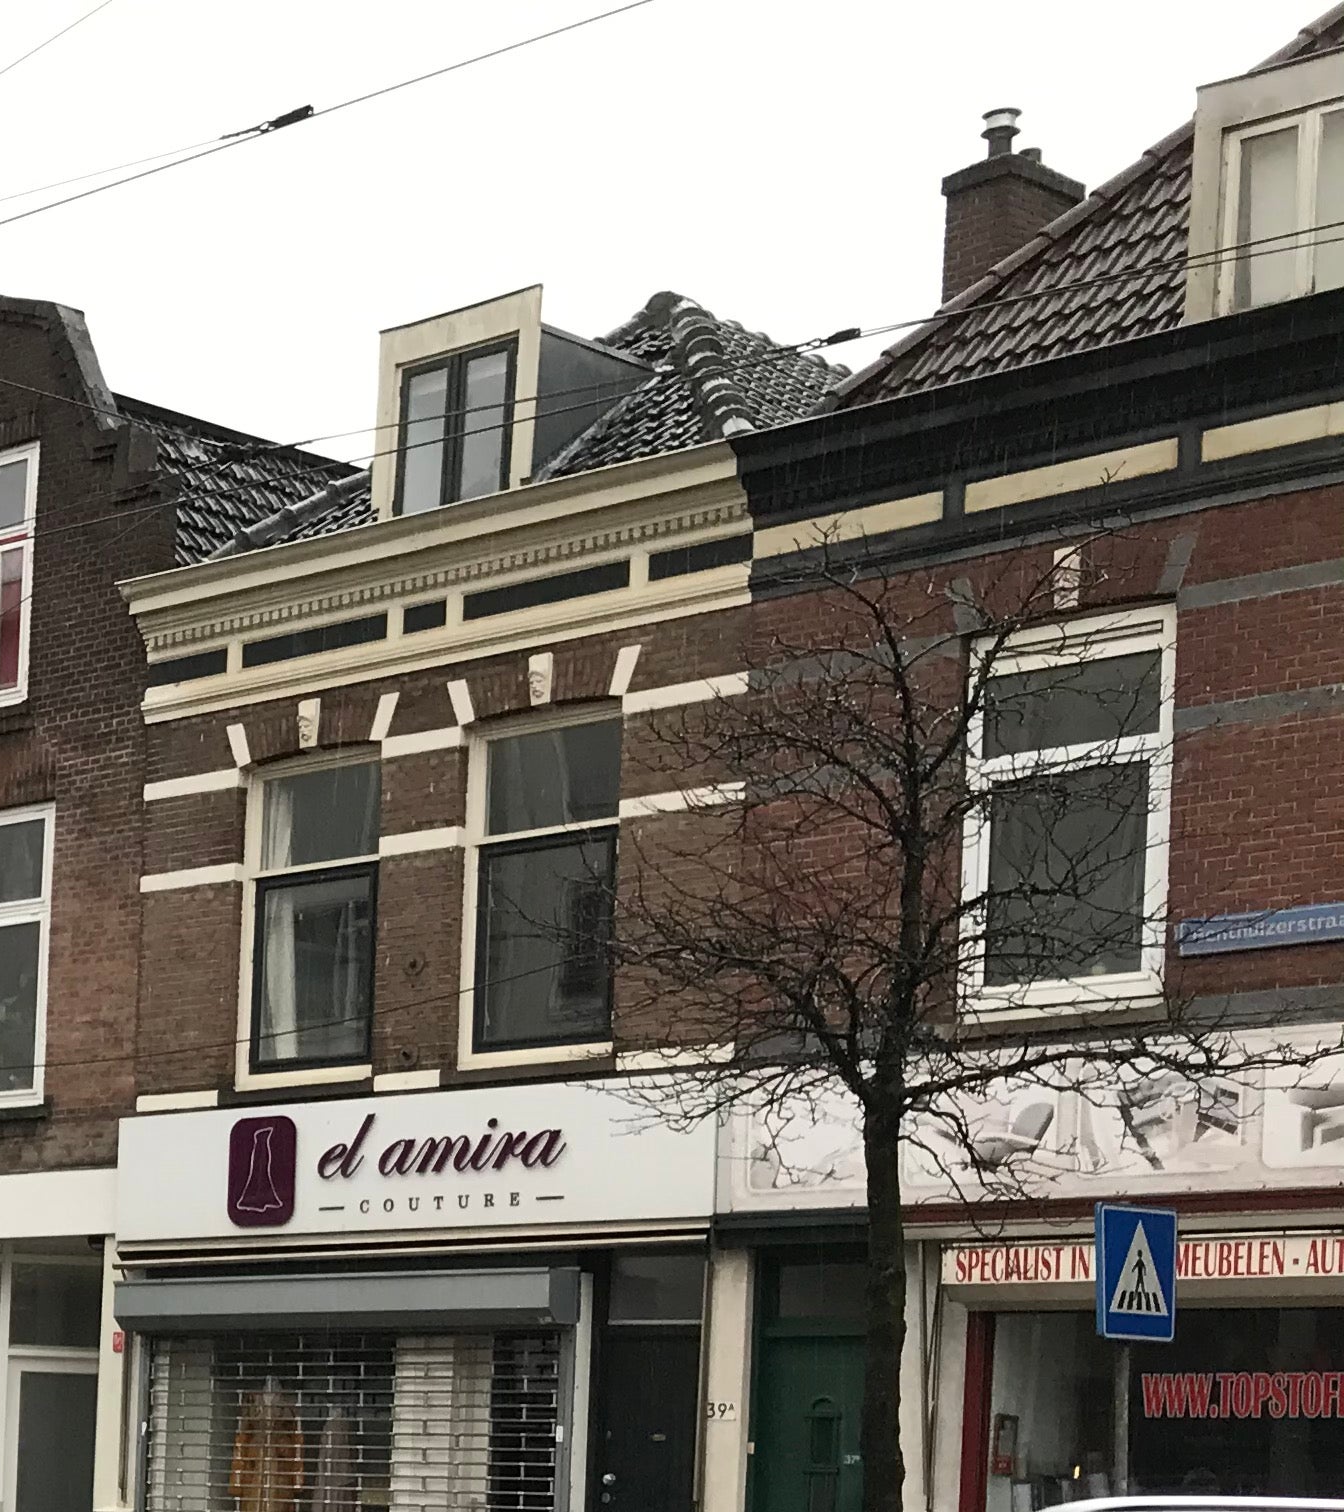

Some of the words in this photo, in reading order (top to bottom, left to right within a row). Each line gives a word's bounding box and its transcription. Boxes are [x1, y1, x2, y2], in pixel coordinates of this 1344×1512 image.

[317, 1113, 376, 1180] el
[378, 1118, 567, 1177] amira
[359, 1192, 520, 1214] COUTURE
[956, 1246, 1065, 1282] SPECIALIST
[1071, 1245, 1091, 1280] IN
[1176, 1240, 1285, 1277] MEUBELEN
